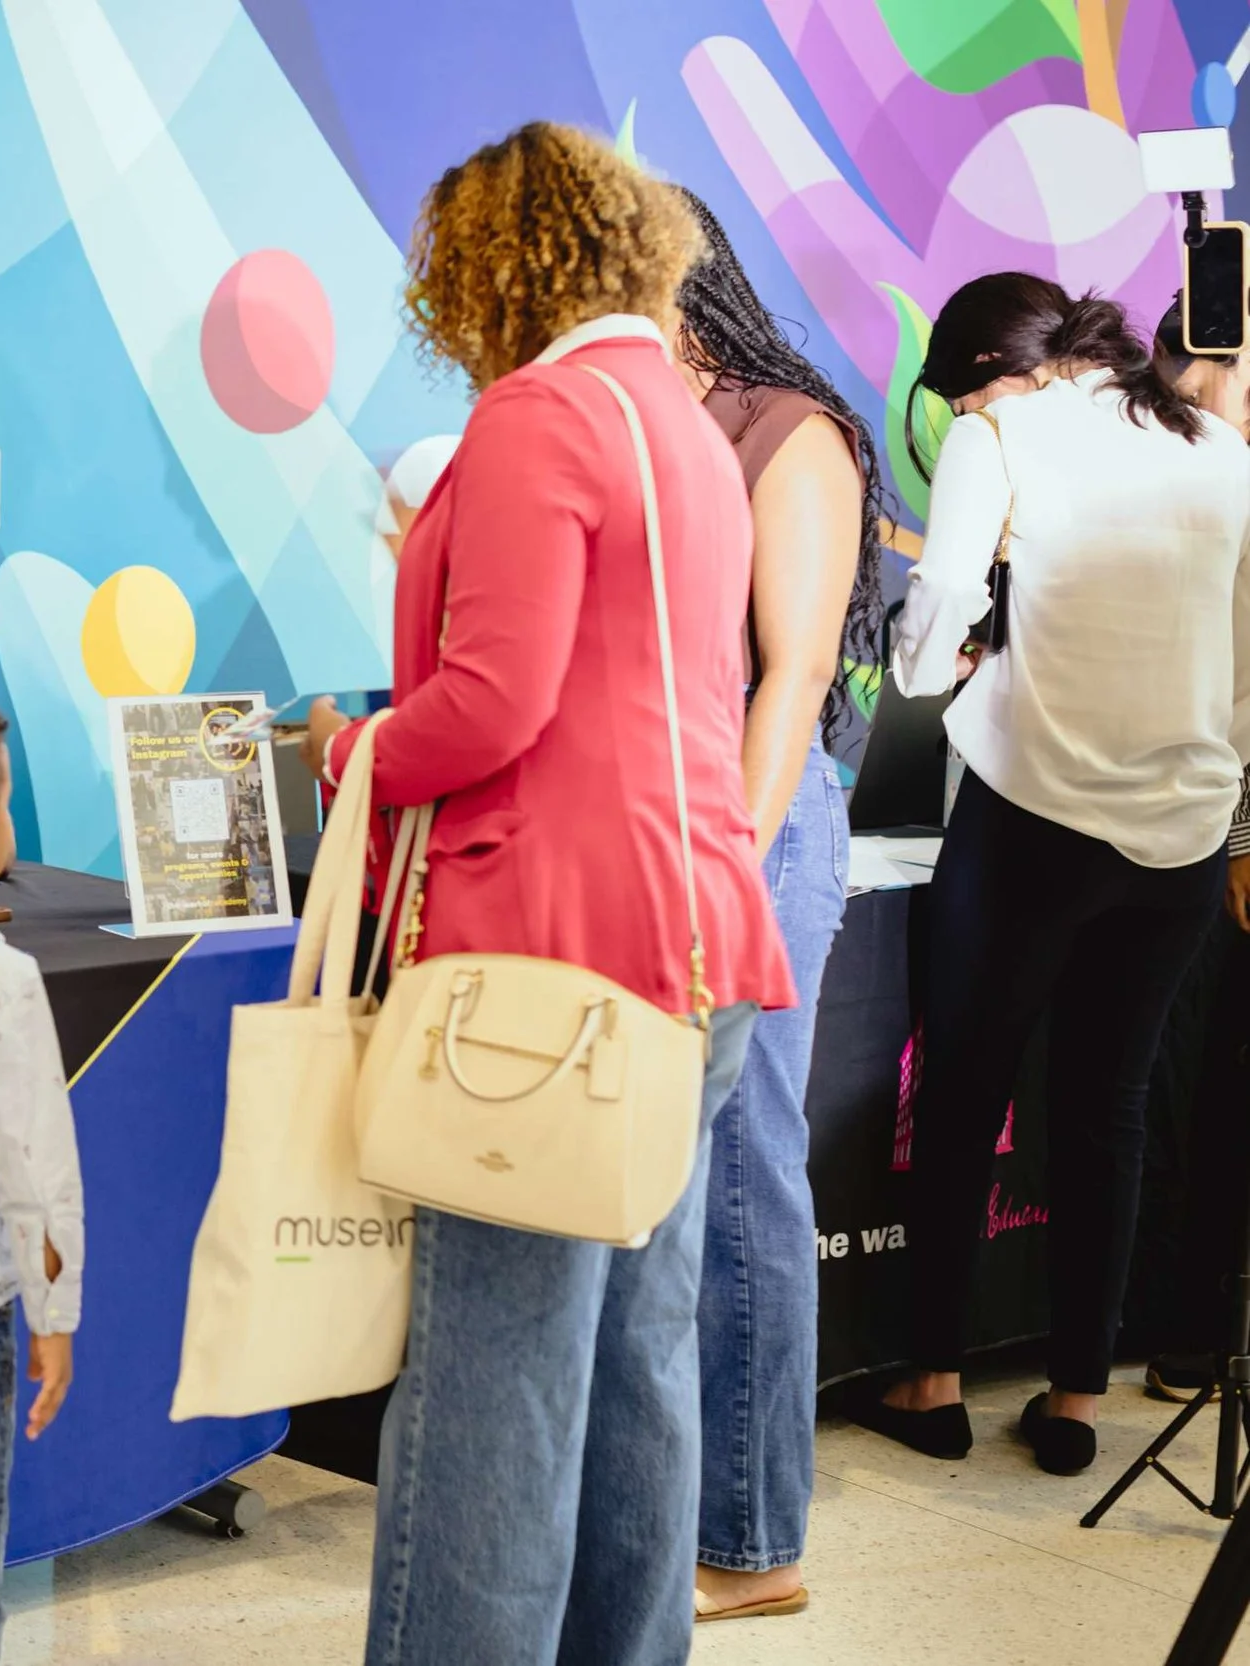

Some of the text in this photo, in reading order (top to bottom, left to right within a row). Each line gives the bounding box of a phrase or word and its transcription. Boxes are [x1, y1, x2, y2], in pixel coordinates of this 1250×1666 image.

[131, 736, 165, 746] Follow
[184, 735, 198, 744] on
[814, 1224, 906, 1260] he wa
